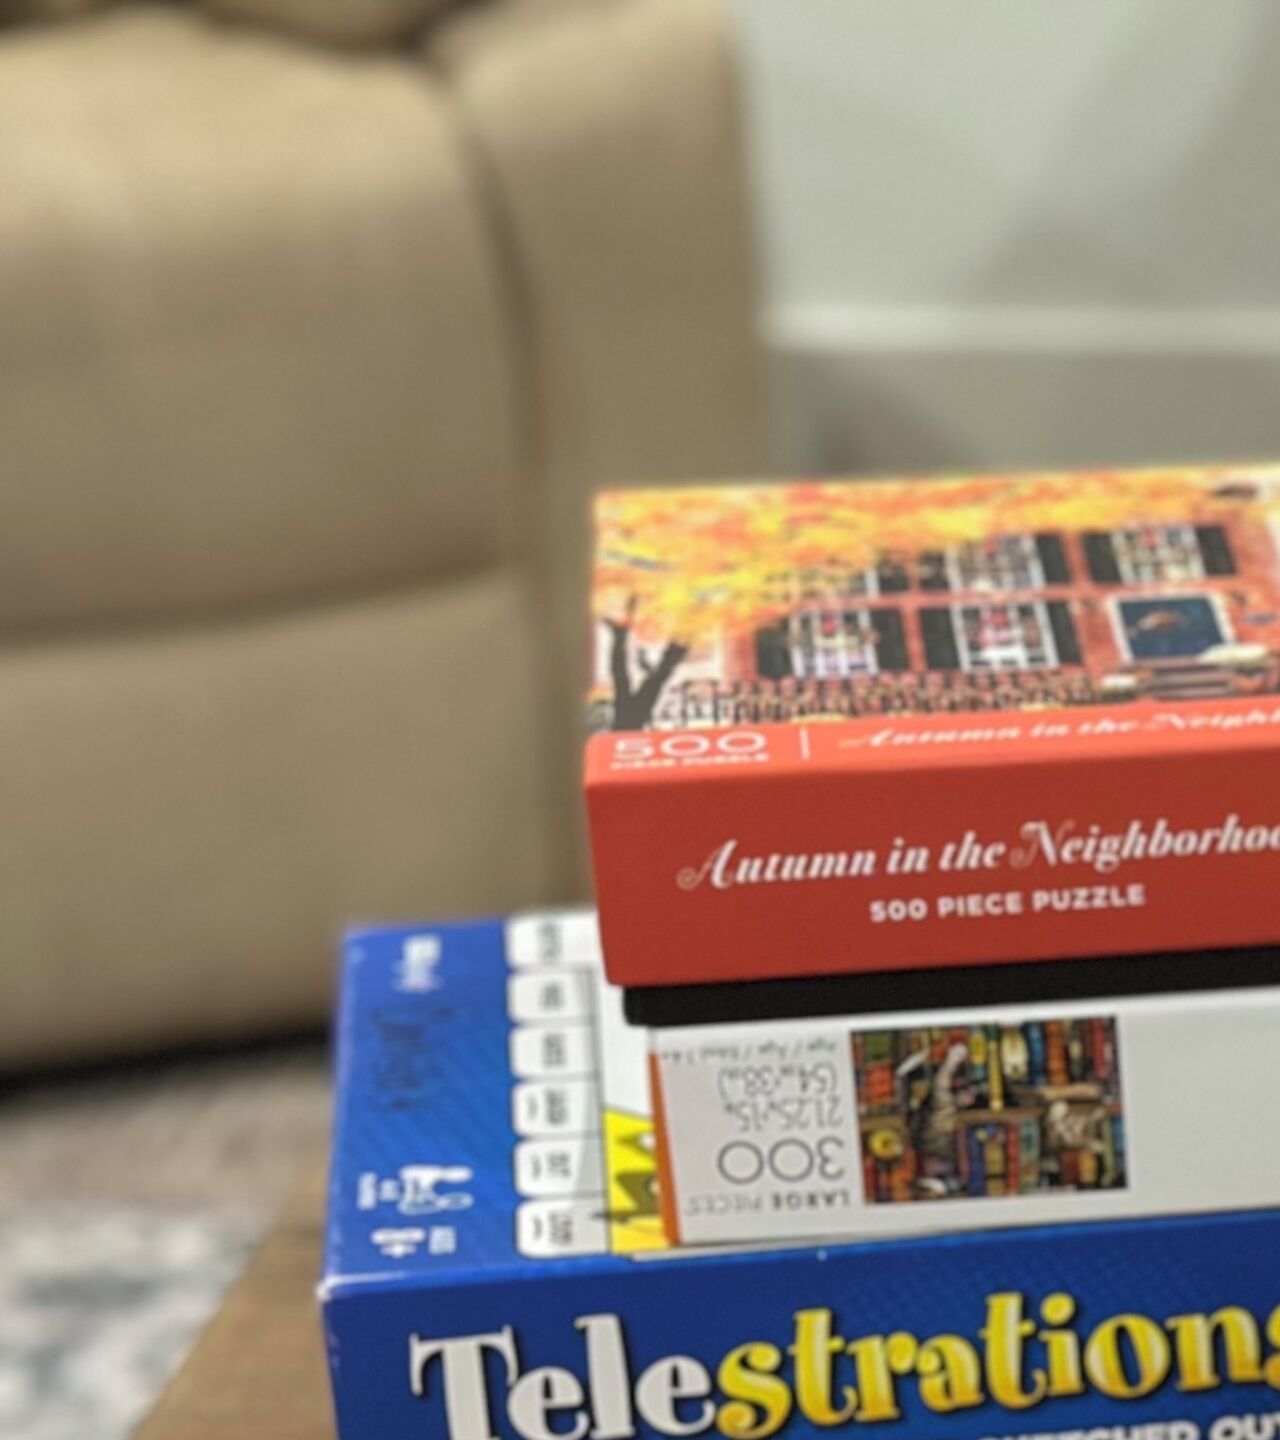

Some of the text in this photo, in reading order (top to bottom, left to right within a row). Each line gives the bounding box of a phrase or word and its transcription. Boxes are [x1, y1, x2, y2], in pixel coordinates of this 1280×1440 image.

[613, 731, 766, 760] 500
[677, 839, 875, 890] Autumn
[886, 836, 931, 876] in
[938, 830, 1006, 871] the
[869, 884, 1147, 923] 500 PIECE PUZZLE
[717, 1135, 846, 1186] 300
[771, 1188, 851, 1210] LARGE
